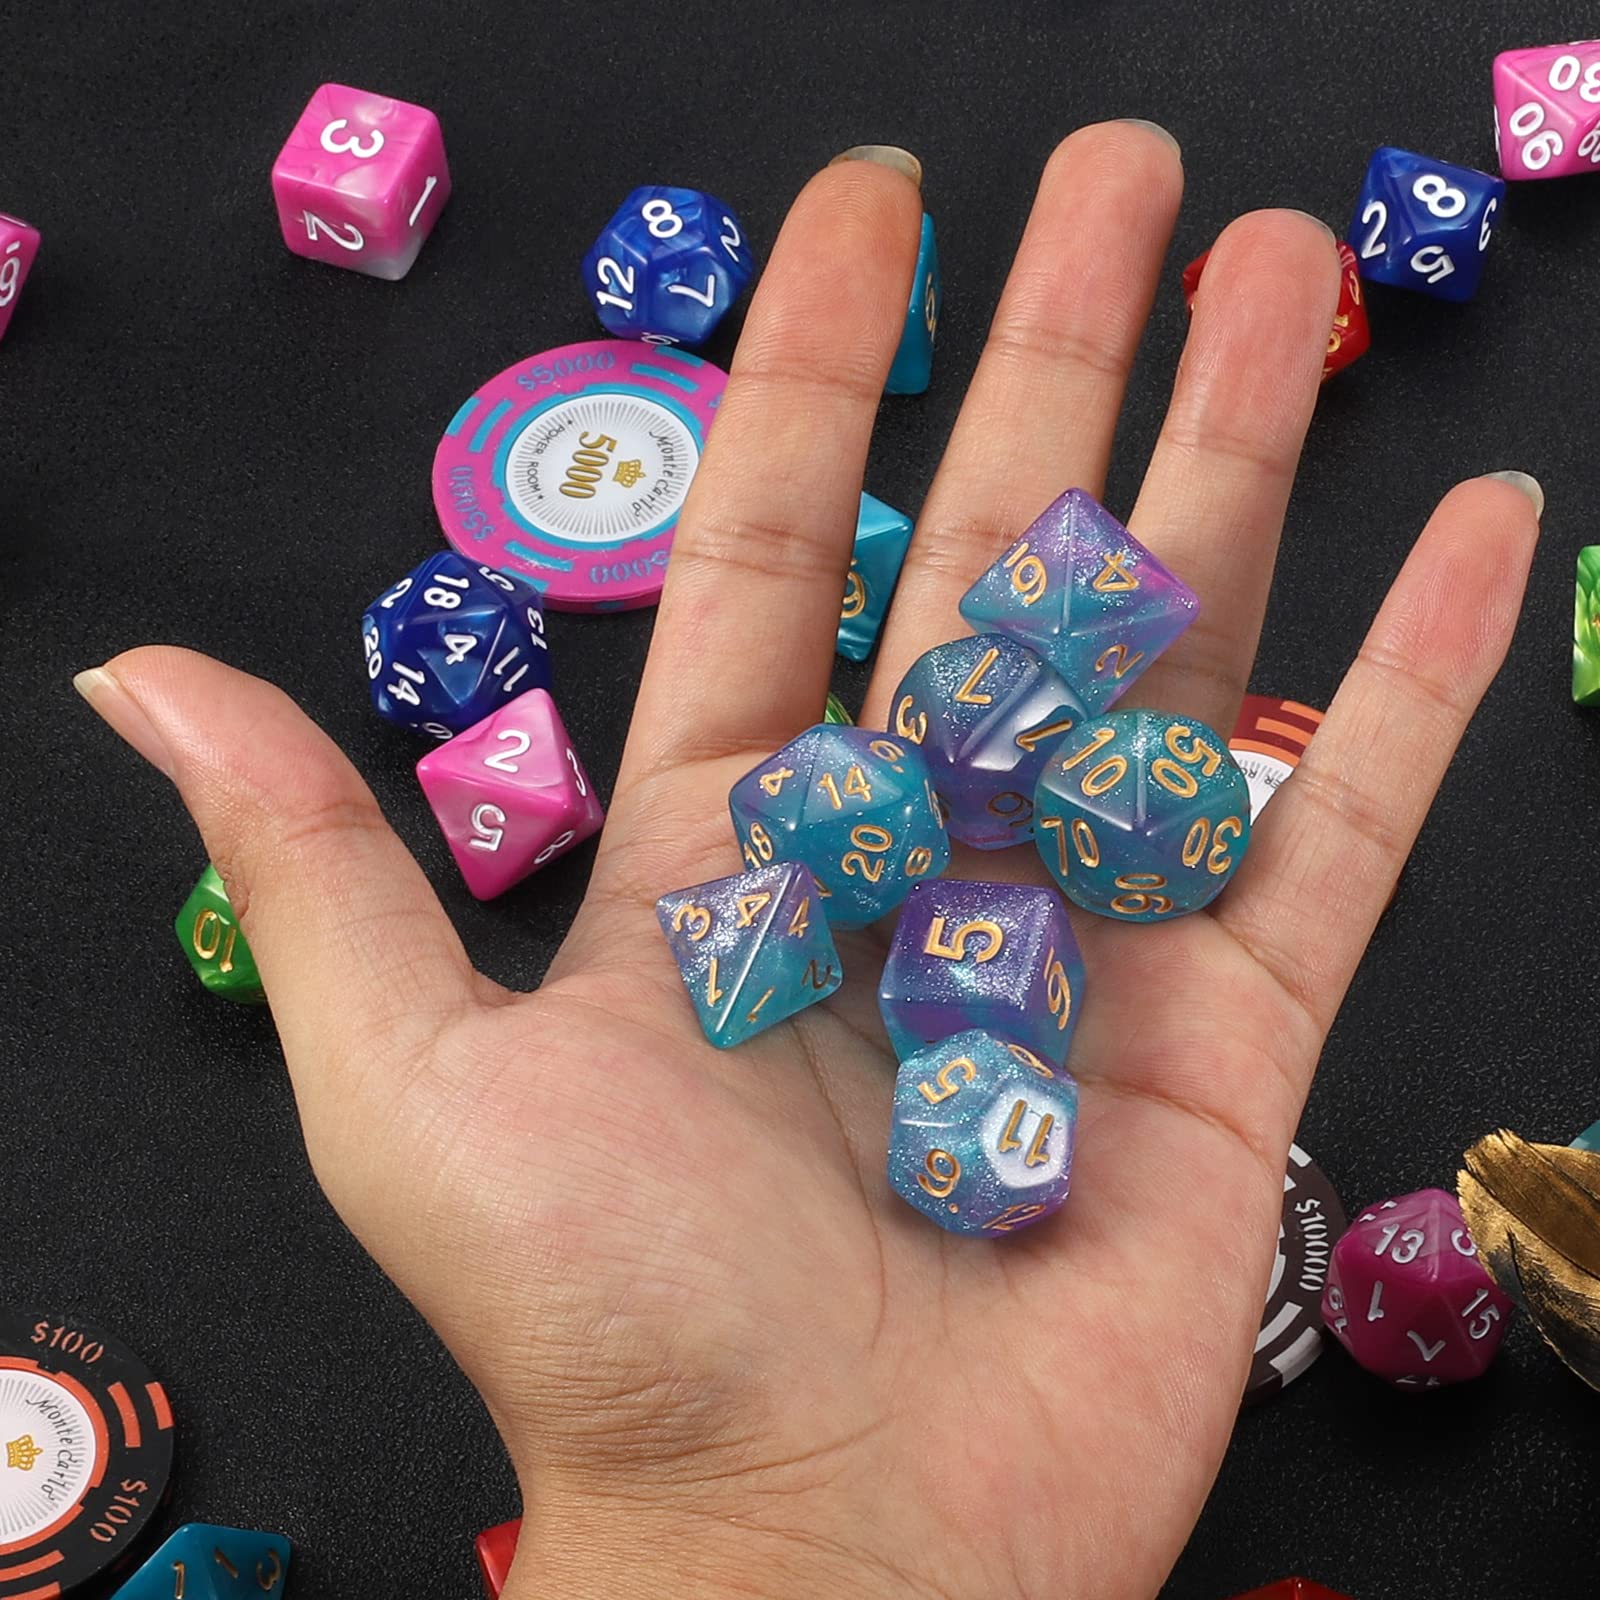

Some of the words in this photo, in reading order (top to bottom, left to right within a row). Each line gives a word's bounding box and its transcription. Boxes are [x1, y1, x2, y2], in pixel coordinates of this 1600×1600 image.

[320, 119, 384, 158] 3
[409, 176, 437, 227] 1
[1412, 174, 1466, 218] 8
[303, 209, 364, 250] 2
[641, 199, 683, 239] 8
[720, 215, 741, 263] 2
[1360, 201, 1388, 259] 2
[596, 257, 634, 310] 12
[1410, 245, 1456, 284] 5
[667, 274, 715, 307] 7
[516, 351, 615, 391] $5000
[534, 424, 566, 454] POKER
[648, 431, 678, 478] Monte
[526, 461, 542, 493] ROOM
[558, 431, 618, 499] 5000
[632, 479, 671, 518] Carlo
[424, 574, 470, 609] 18
[1093, 553, 1139, 593] 4
[444, 633, 478, 665] 4
[526, 606, 548, 650] 13
[363, 626, 382, 679] 20
[493, 646, 530, 692] 11
[1095, 644, 1144, 679] 2
[387, 661, 425, 706] 14
[955, 648, 999, 704] 7
[896, 695, 928, 745] 3
[483, 729, 532, 773] 2
[1062, 727, 1128, 798] 10
[1151, 725, 1221, 799] 50
[759, 767, 794, 796] 4
[818, 767, 872, 811] 14
[468, 802, 507, 852] 5
[743, 822, 774, 869] 18
[1041, 817, 1100, 876] 70
[1181, 817, 1242, 875] 30
[841, 824, 894, 883] 20
[673, 904, 711, 941] 3
[737, 891, 771, 930] 4
[787, 896, 811, 938] 4
[923, 917, 1004, 963] 5
[918, 1057, 977, 1105] 5
[998, 1099, 1055, 1169] 11
[1374, 1223, 1425, 1264] 13
[1367, 1280, 1385, 1321] 1
[1461, 1287, 1500, 1339] 15
[31, 1320, 104, 1364] $100
[26, 1398, 73, 1445] Monte
[41, 1449, 78, 1501] Carlo
[89, 1478, 149, 1543] $100
